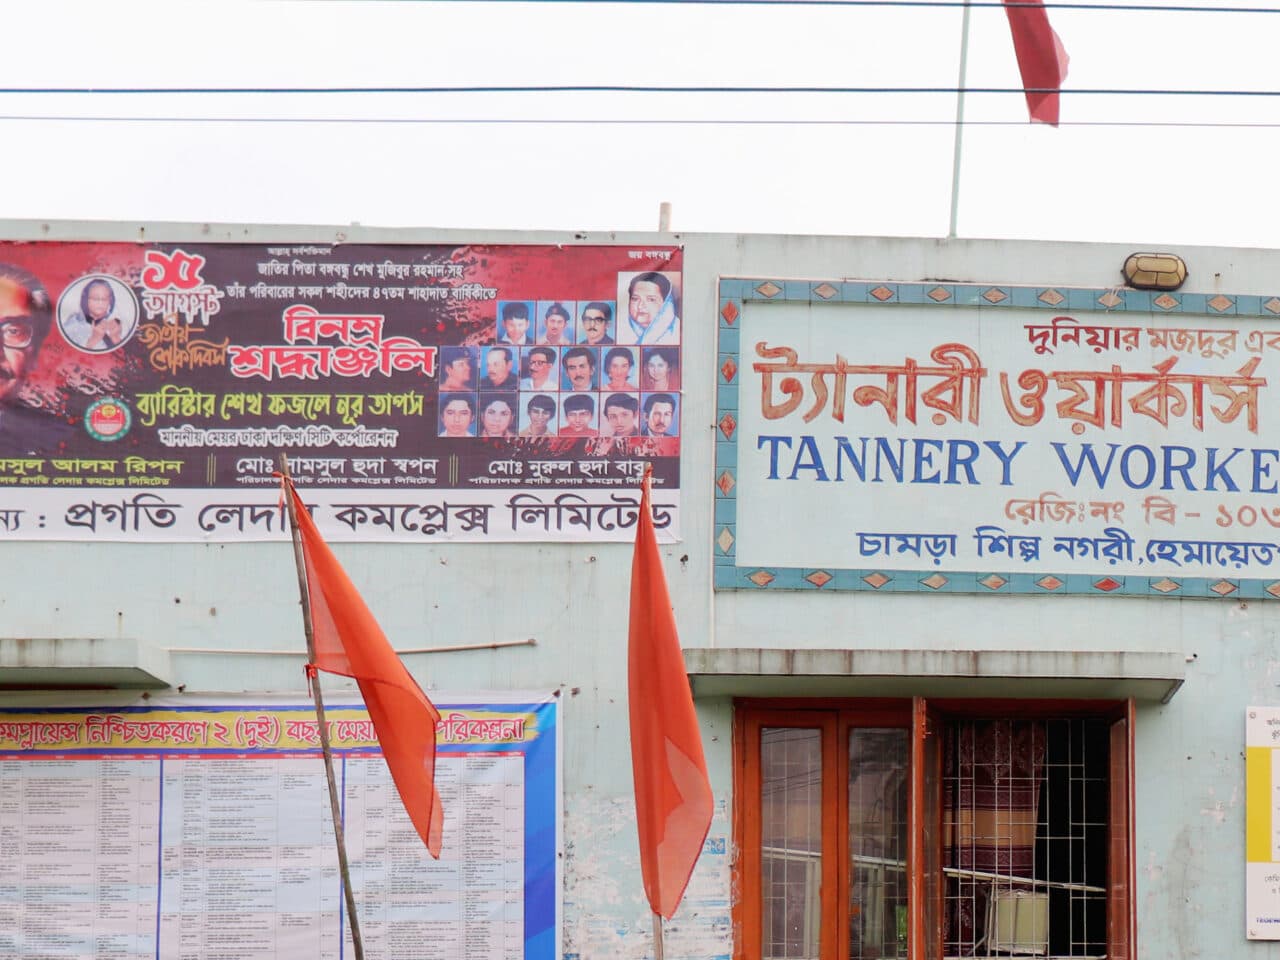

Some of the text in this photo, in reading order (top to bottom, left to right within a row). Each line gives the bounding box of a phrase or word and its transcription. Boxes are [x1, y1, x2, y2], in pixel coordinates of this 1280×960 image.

[142, 250, 206, 291] ১৫
[257, 260, 445, 279] জাতির পিতা বঙ্গবন্ধু শেখ মুজিবুর রহমান
[226, 281, 498, 301] তাঁর পরিবারের সকল শহীদের ৪৭তম শাহাদাত বার্ষিকীতে
[282, 304, 385, 347] বিনম্র
[1024, 317, 1141, 354] দুনিয়ার
[1146, 326, 1239, 360] মজদুর
[227, 336, 438, 381] শ্রদ্ধাঞ্জলি
[136, 384, 424, 426] ব্যারিস্টার শেখ ফজলে নূর তাপস
[752, 341, 988, 427] ট্যানারী
[1000, 356, 1267, 435] ওয়ার্কার্স
[158, 424, 203, 447] মাননীয়
[205, 428, 238, 446] মেয়র
[240, 427, 267, 447] ঢাকা
[269, 425, 303, 447] দক্ষিণ
[305, 425, 332, 447] সিটি
[51, 456, 184, 475] আলম রিপন
[236, 457, 439, 477] মোঃ হুদা স্বপন
[488, 459, 524, 475] মোঃ
[528, 459, 574, 477] নুরুল
[579, 460, 609, 479] হুদা
[757, 436, 1027, 486] TANNERY
[65, 493, 184, 533] প্রগতি
[331, 499, 496, 535] কমপ্লেক্স
[1142, 495, 1176, 525] বি
[855, 532, 957, 565] চামড়া
[973, 525, 1041, 563] শিল্প
[85, 714, 281, 749] নিশ্চিতকরণে ২ (দুই)
